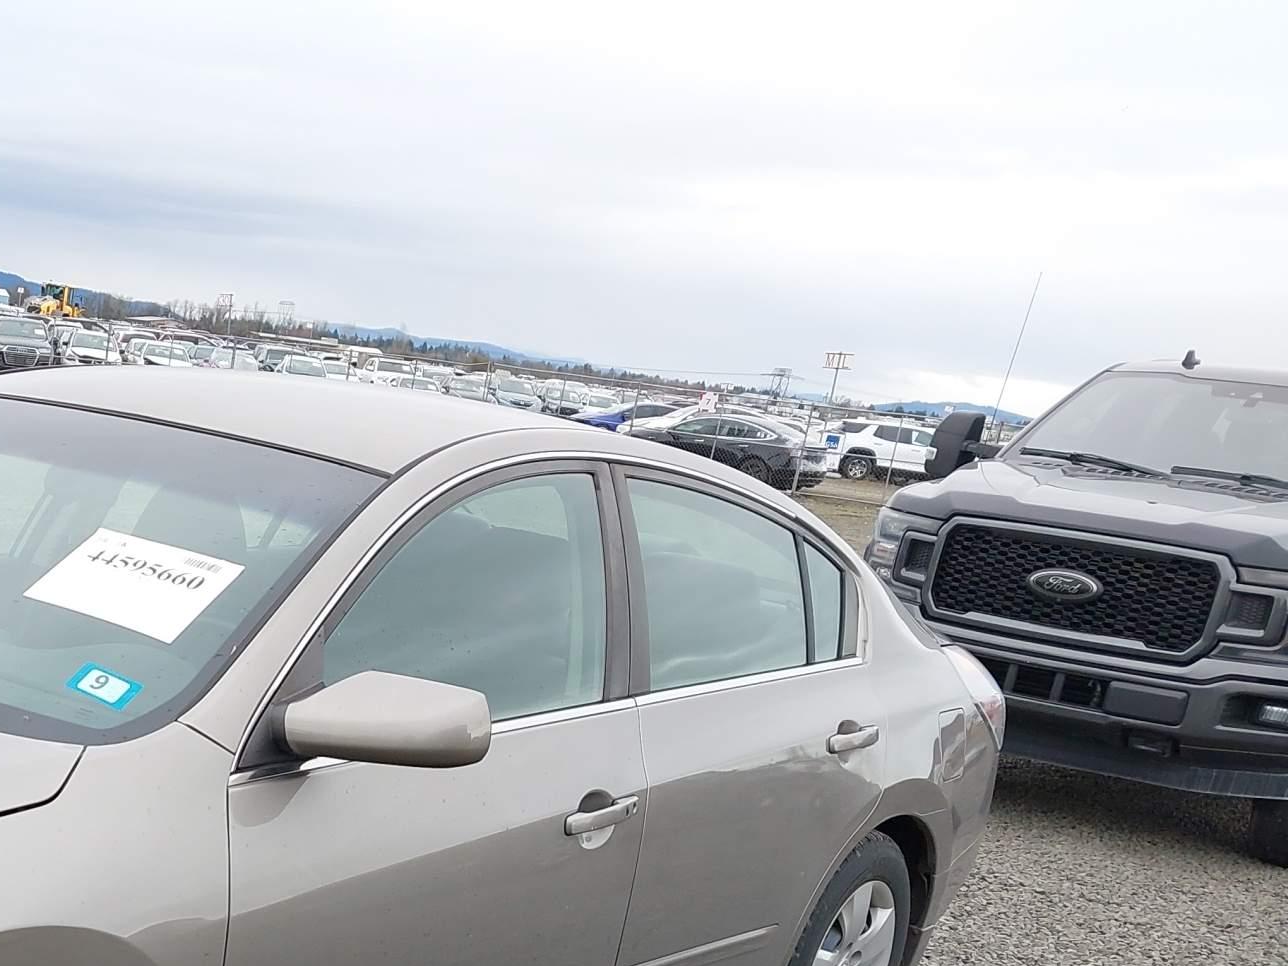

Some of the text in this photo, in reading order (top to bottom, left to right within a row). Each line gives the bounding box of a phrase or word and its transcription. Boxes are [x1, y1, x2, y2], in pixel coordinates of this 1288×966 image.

[87, 550, 205, 590] 44595660
[1044, 575, 1082, 594] Ford
[89, 674, 110, 690] 9
